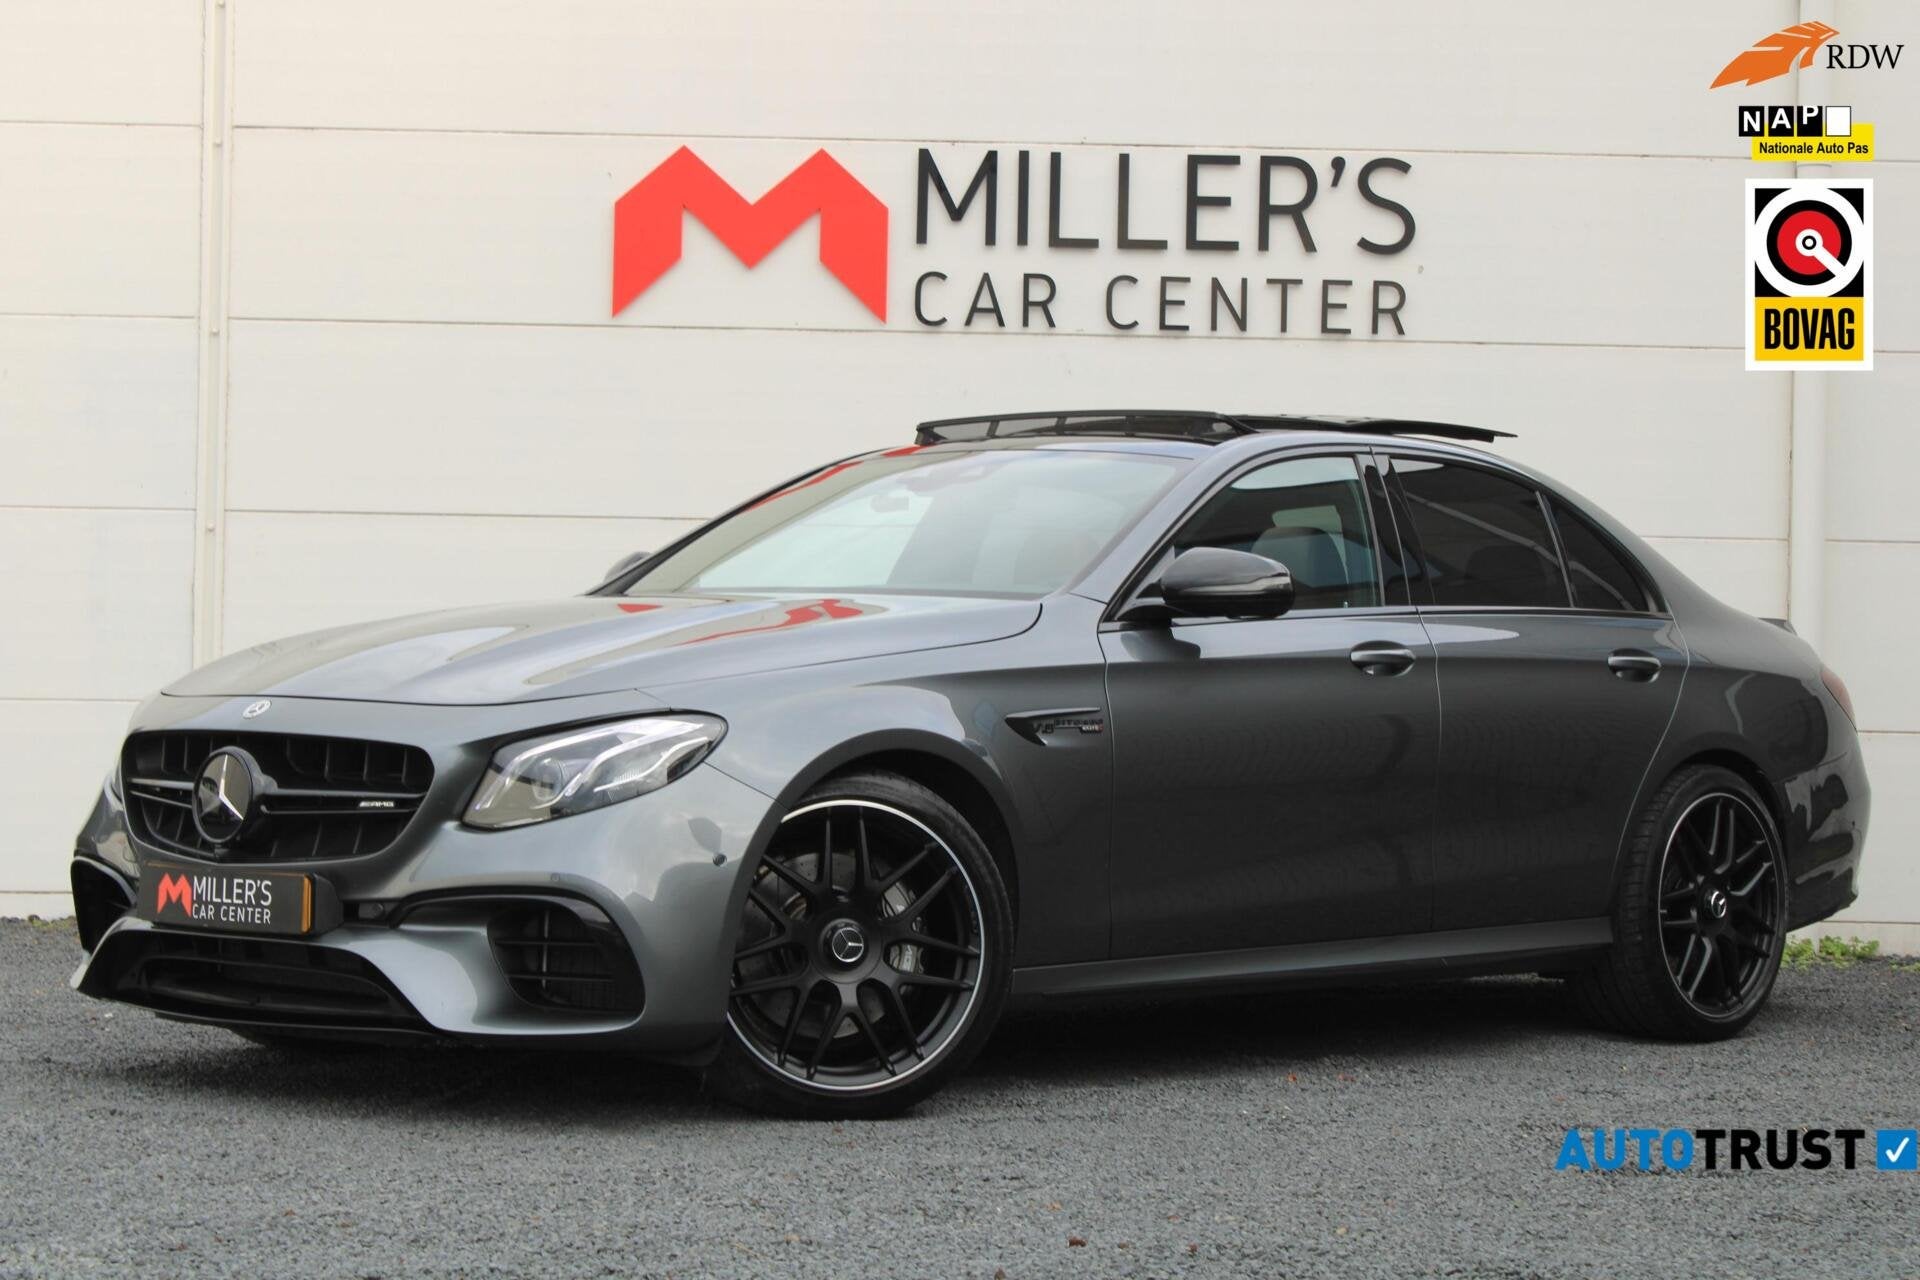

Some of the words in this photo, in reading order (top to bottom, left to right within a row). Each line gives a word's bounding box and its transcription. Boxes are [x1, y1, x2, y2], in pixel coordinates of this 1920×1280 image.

[915, 147, 1417, 256] MILLER'S
[914, 271, 1058, 329] CAR
[1105, 274, 1407, 336] CENTER
[192, 903, 215, 920] CAR
[220, 906, 271, 924] CENTER
[193, 875, 272, 906] MILLER'S
